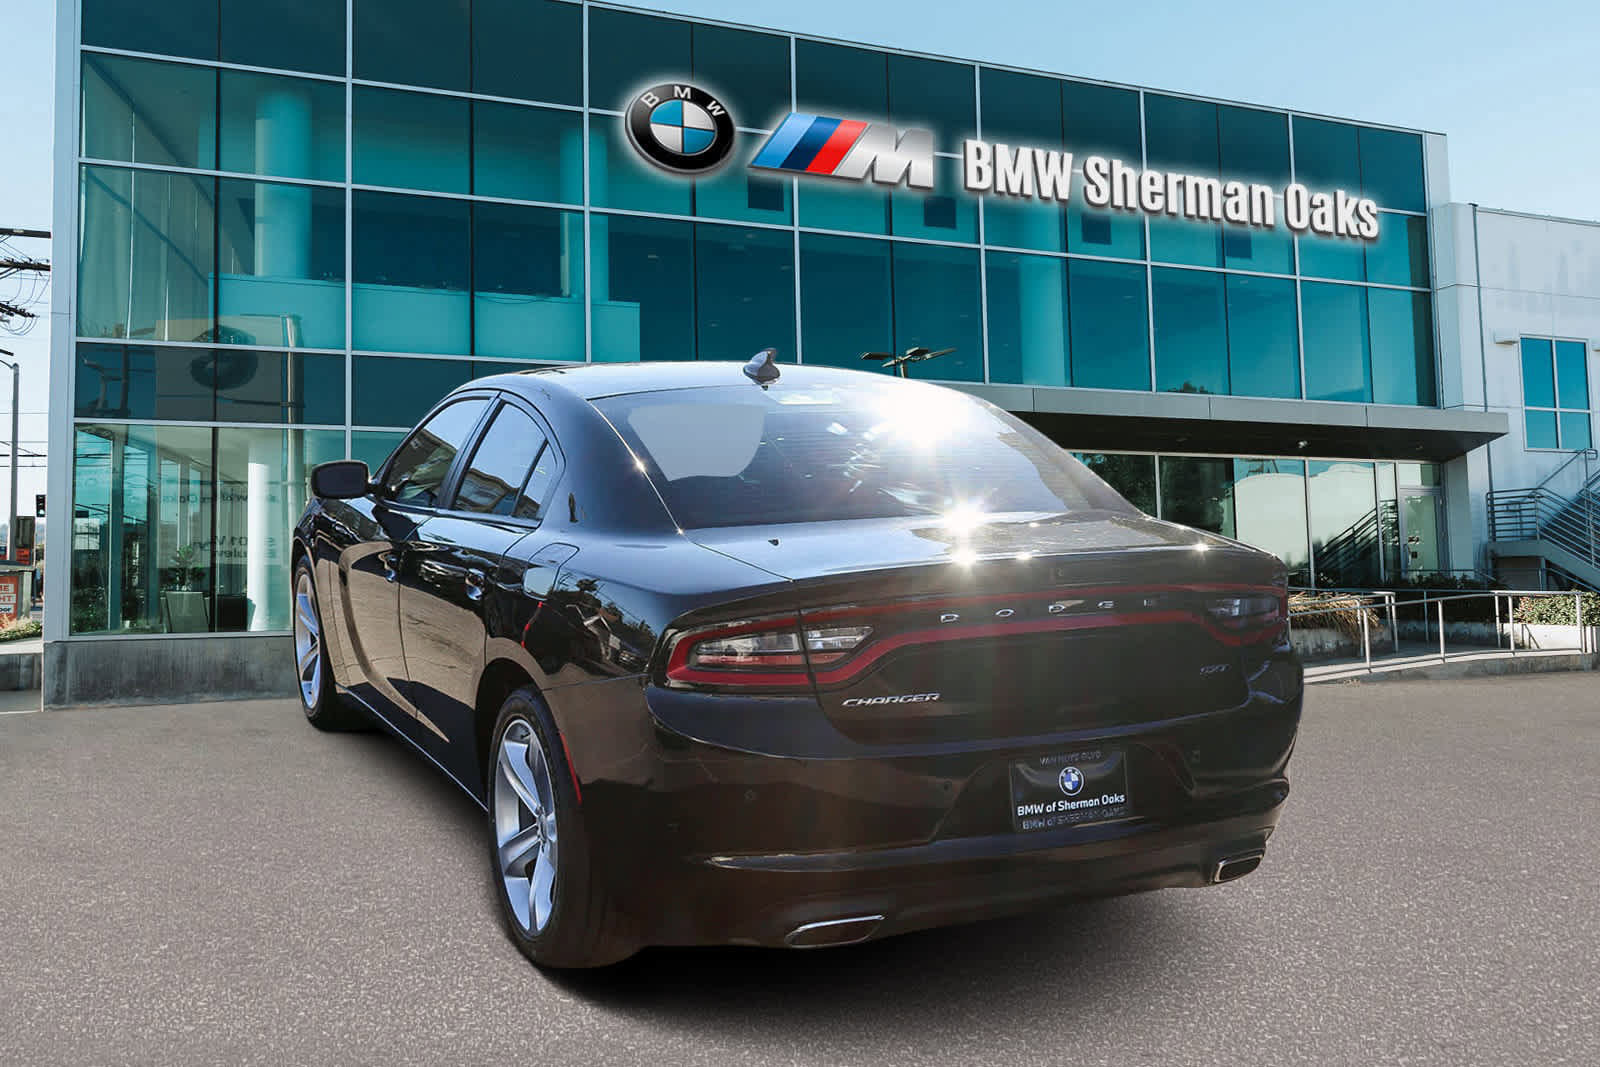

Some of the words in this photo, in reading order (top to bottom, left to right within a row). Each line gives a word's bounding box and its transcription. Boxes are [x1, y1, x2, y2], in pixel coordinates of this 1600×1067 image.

[641, 84, 725, 117] BMW
[963, 139, 1073, 201] BMW
[1083, 156, 1274, 227] Sherman
[1284, 183, 1380, 240] Oaks
[841, 692, 940, 707] CHARGER
[1017, 803, 1045, 816] BMW
[1046, 801, 1057, 813] of
[1058, 797, 1100, 811] Sherman
[1101, 793, 1126, 804] Oaks
